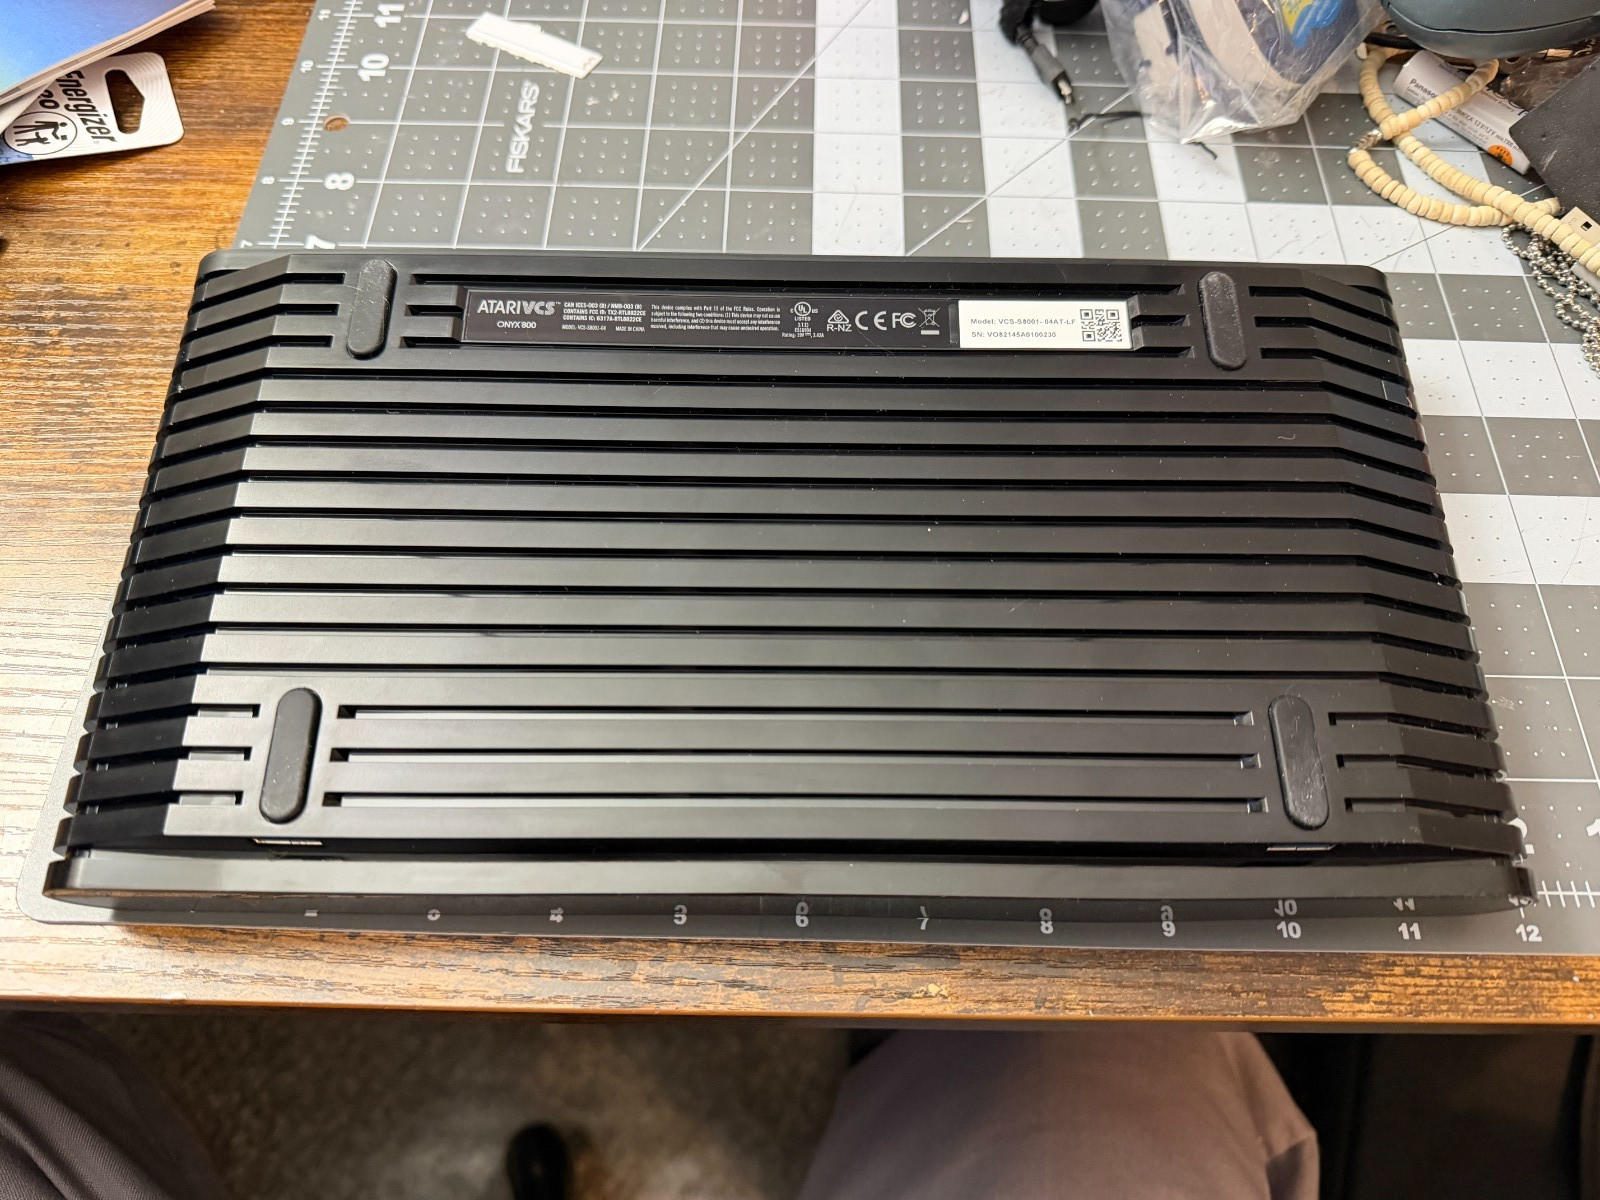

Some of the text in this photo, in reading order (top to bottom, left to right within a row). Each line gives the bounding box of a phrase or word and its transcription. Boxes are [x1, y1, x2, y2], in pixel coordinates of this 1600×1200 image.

[317, 9, 331, 21] 11
[374, 4, 405, 27] 11
[299, 60, 314, 73] 10
[358, 53, 389, 81] 10
[1409, 77, 1438, 100] Panaso
[55, 70, 117, 142] Energizer
[505, 78, 540, 174] FISKARS
[324, 173, 355, 190] 8
[795, 914, 809, 928] 6
[1162, 920, 1176, 937] 9
[1277, 921, 1301, 939] 10
[1398, 922, 1422, 940] 11
[1515, 924, 1542, 942] 12
